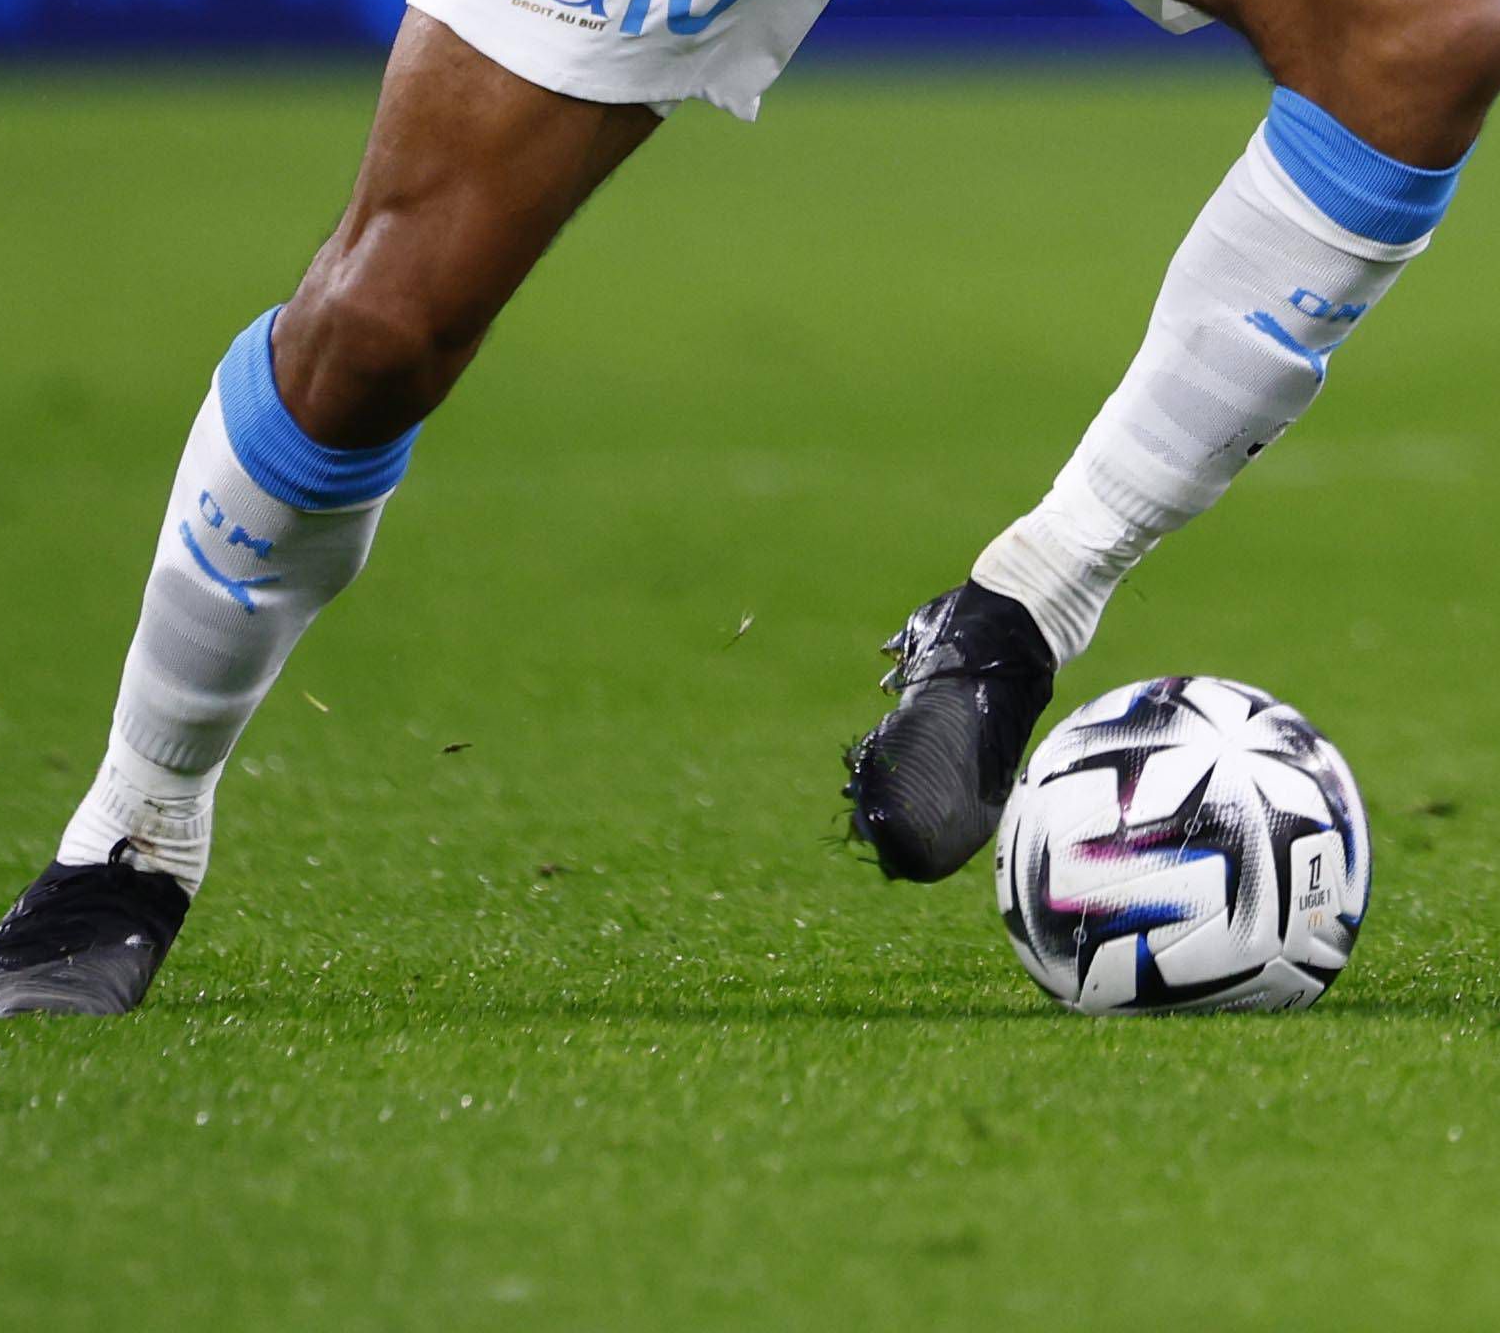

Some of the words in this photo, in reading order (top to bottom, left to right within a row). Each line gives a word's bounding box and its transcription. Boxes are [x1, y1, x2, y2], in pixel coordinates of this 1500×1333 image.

[556, 12, 577, 25] AU
[579, 18, 607, 32] BUT
[199, 489, 274, 559] OM
[1299, 891, 1325, 912] LIGUE
